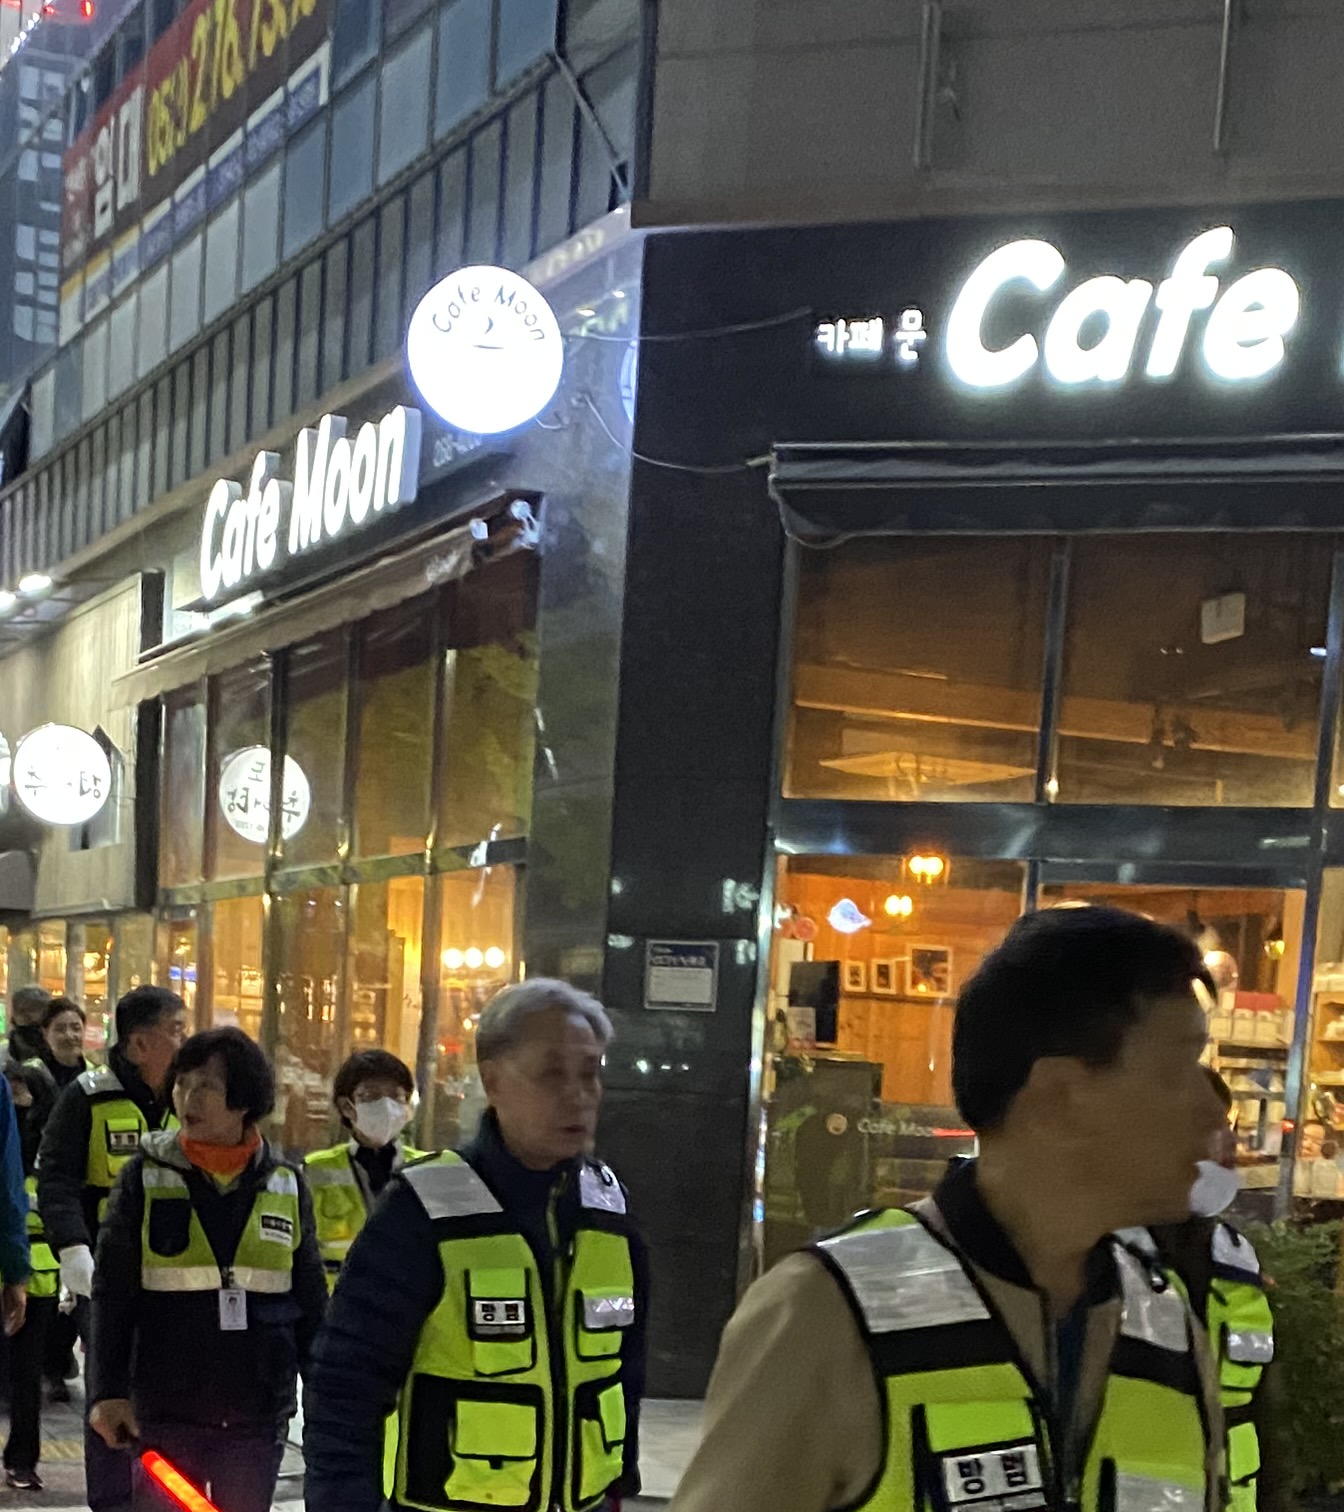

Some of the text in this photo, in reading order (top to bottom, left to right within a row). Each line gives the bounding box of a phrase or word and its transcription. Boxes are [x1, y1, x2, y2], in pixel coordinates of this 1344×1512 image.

[432, 284, 545, 341] Cafe Moon
[816, 317, 883, 352] 카페
[946, 226, 1300, 387] Cafe
[200, 404, 418, 600] Cafe Moon
[899, 1119, 935, 1138] Moo
